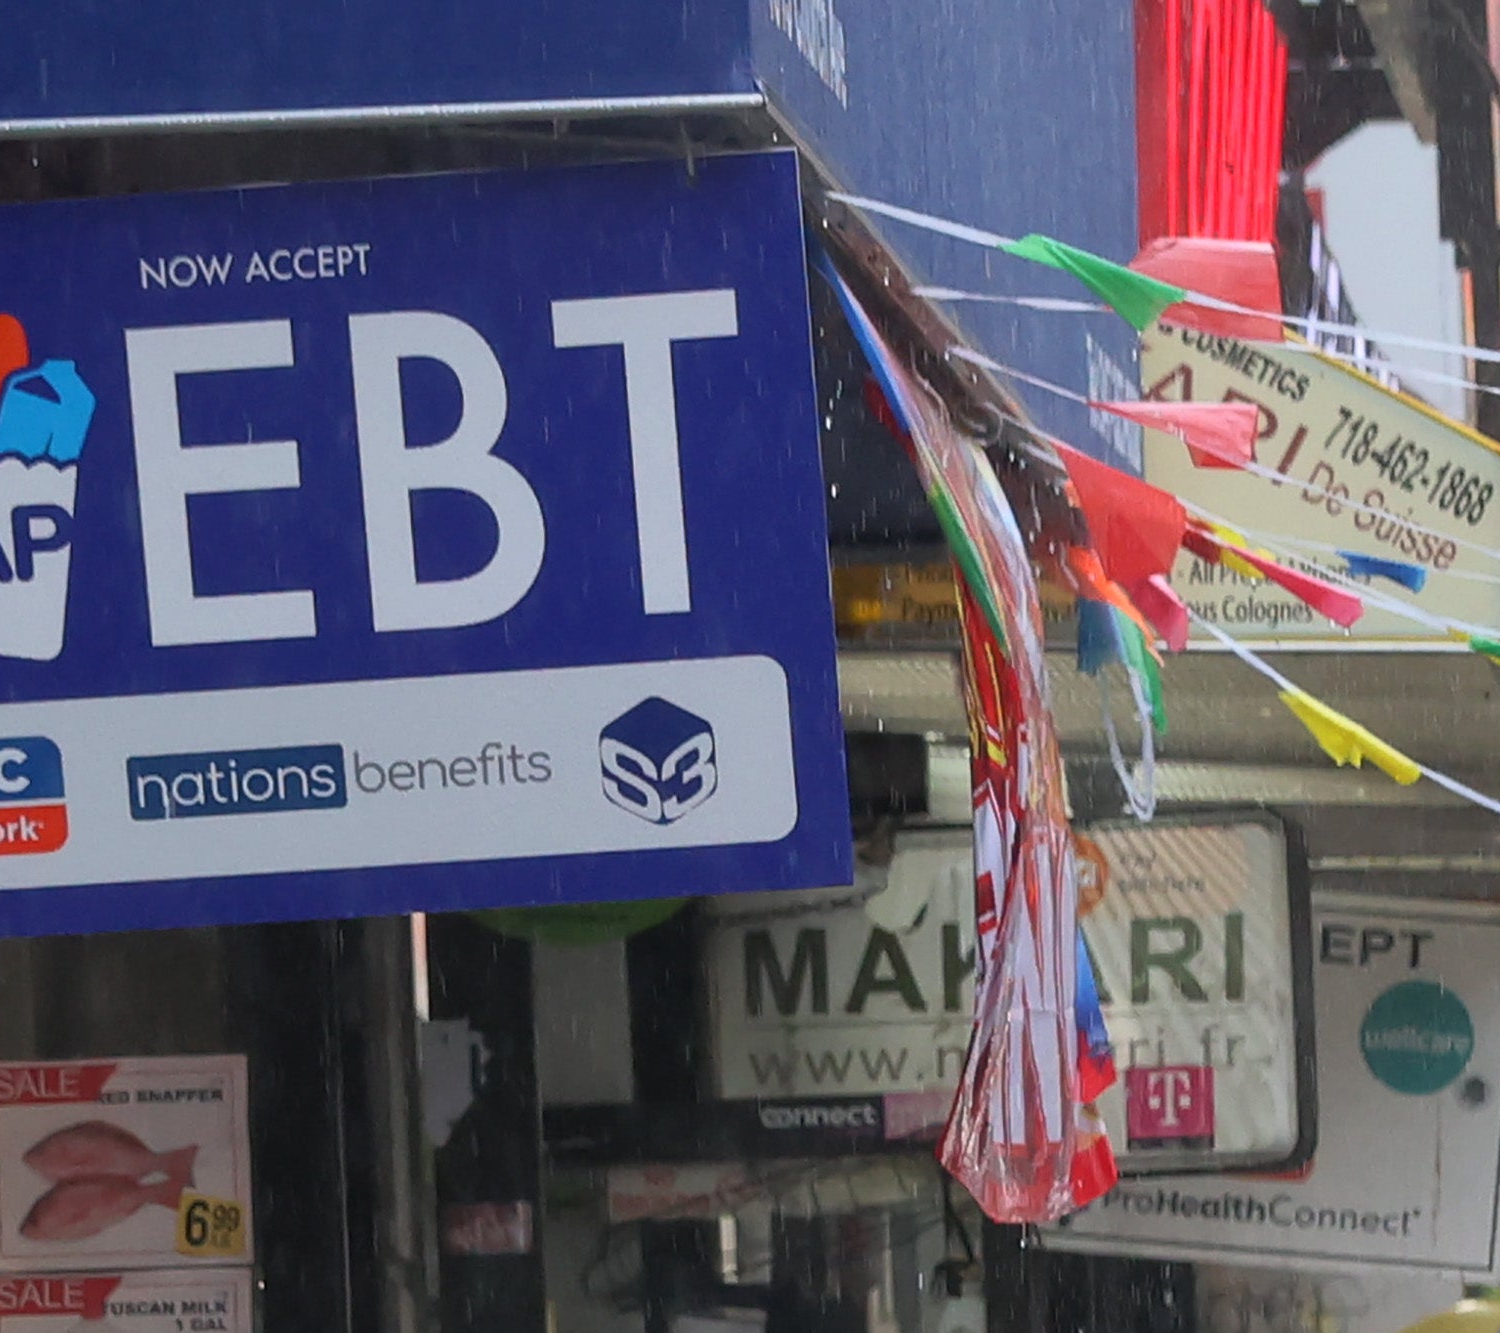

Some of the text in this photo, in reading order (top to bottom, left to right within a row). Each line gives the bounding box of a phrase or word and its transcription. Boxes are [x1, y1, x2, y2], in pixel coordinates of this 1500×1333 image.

[140, 245, 372, 290] NOW ACCEPT
[125, 289, 739, 648] EBT
[1324, 404, 1494, 527] 718-462-1868
[1301, 460, 1349, 516] De
[1354, 488, 1457, 571] Suisse
[1222, 596, 1313, 630] Colognes
[136, 742, 552, 814] nations benefits
[744, 914, 1245, 1018] MAKRI
[1147, 1071, 1192, 1127] T
[180, 1299, 229, 1316] MILK
